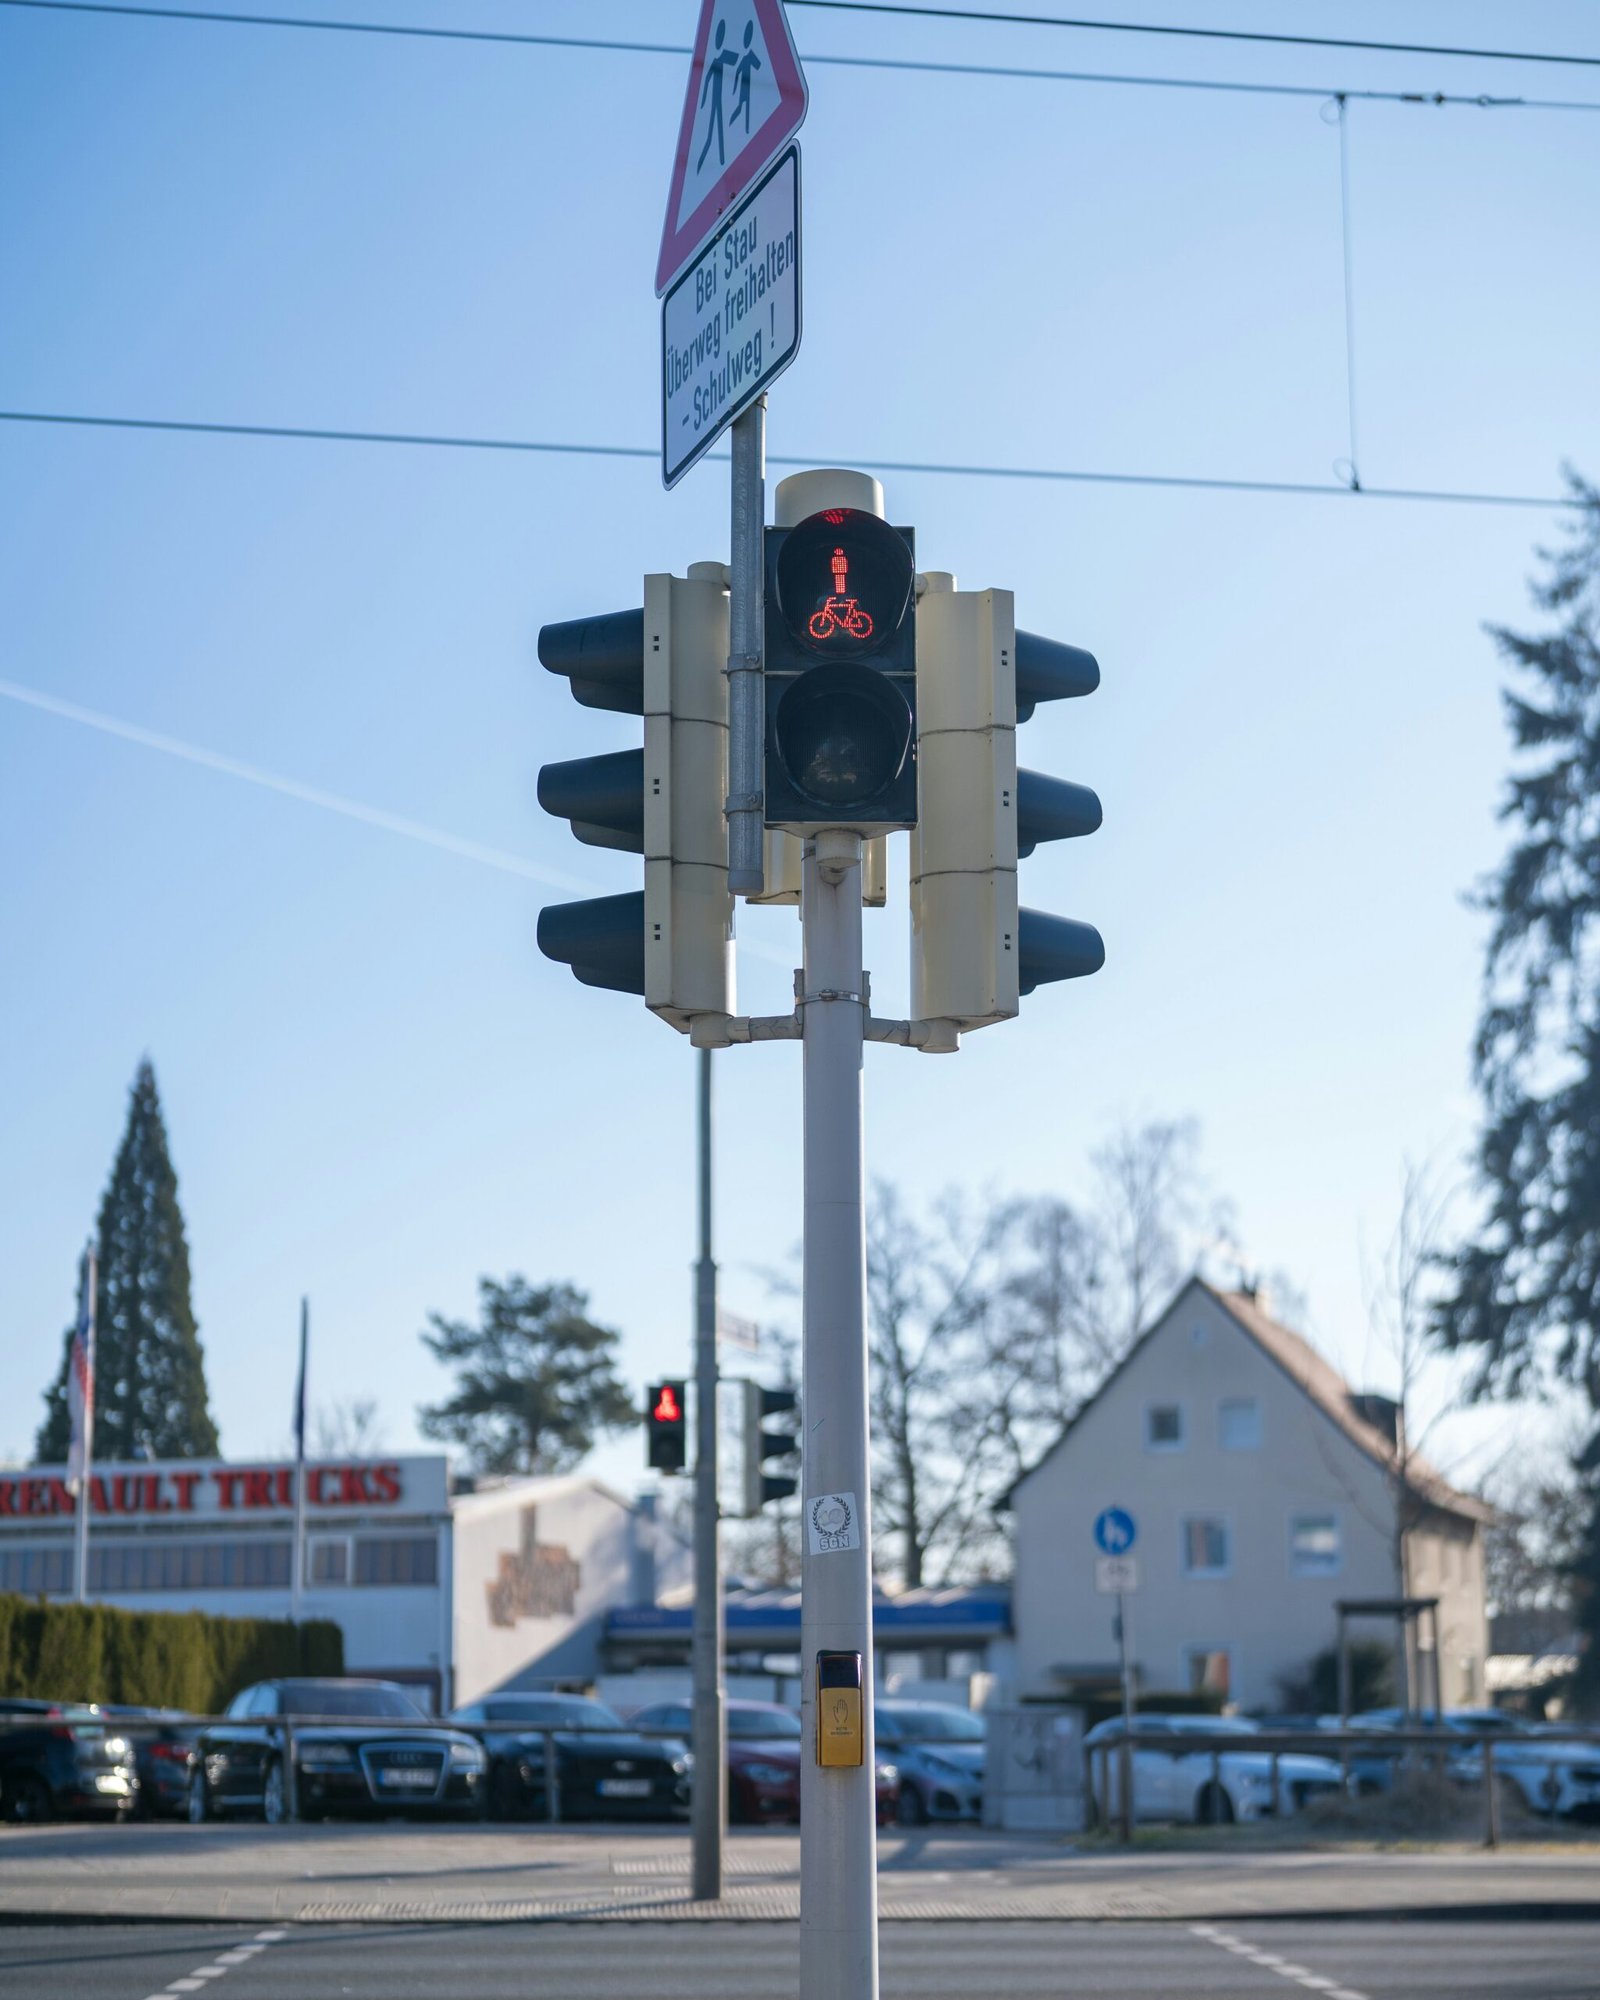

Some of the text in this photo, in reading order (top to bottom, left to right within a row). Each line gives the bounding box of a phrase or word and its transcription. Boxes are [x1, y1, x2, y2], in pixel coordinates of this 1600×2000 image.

[667, 229, 793, 399] Überweg freihalten
[696, 215, 756, 314] Bei Stau
